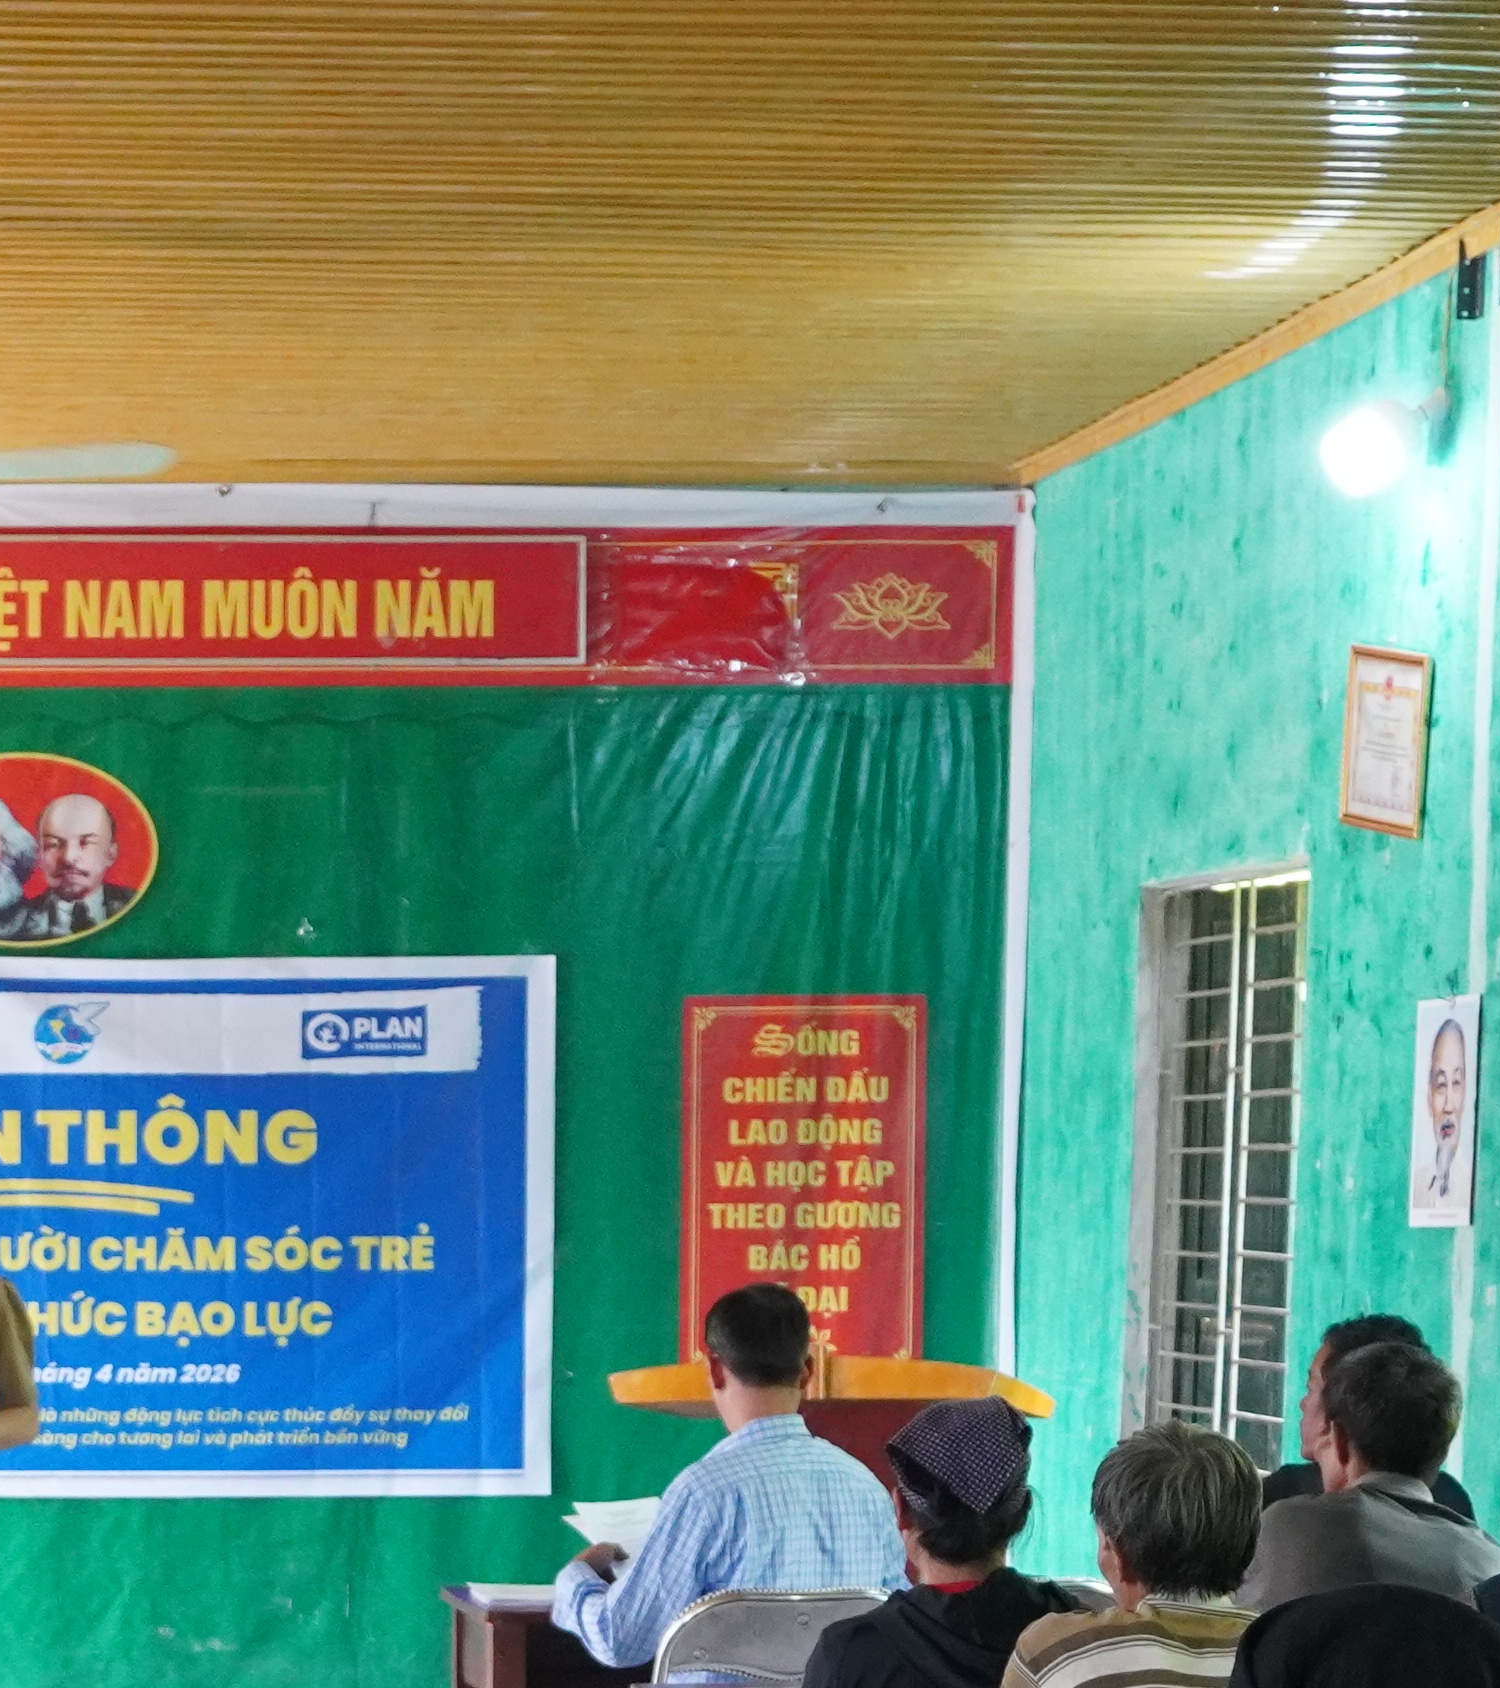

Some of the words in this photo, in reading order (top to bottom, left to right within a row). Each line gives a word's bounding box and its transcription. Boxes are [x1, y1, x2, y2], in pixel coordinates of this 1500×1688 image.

[65, 580, 185, 638] NAM
[202, 567, 357, 638] MUÔN
[374, 567, 495, 638] NĂM
[354, 1016, 423, 1039] PLAN
[752, 1022, 860, 1057] SỐNG
[723, 1067, 817, 1103] CHIẾN
[826, 1067, 889, 1103] ĐẤU
[36, 1093, 319, 1166] THÔNG
[729, 1119, 788, 1145] LAO
[797, 1113, 882, 1150] ĐỘNG
[715, 1155, 756, 1187] VÀ
[765, 1160, 827, 1192] HỌC
[835, 1155, 895, 1192] TẬP
[708, 1203, 786, 1229] THEO
[795, 1200, 901, 1228] GƯƠNG
[90, 1227, 236, 1271] CHĂM
[246, 1225, 343, 1271] SÓC
[350, 1223, 435, 1271] TRẺ
[748, 1239, 809, 1271] BÁC
[819, 1235, 861, 1270] HỒ
[135, 1301, 235, 1347] BẠO
[245, 1297, 333, 1347] LỰC
[96, 1363, 112, 1382] 4
[116, 1362, 176, 1382] năm
[180, 1363, 240, 1383] 2026
[394, 1406, 436, 1425] thay
[81, 1431, 116, 1445] cho
